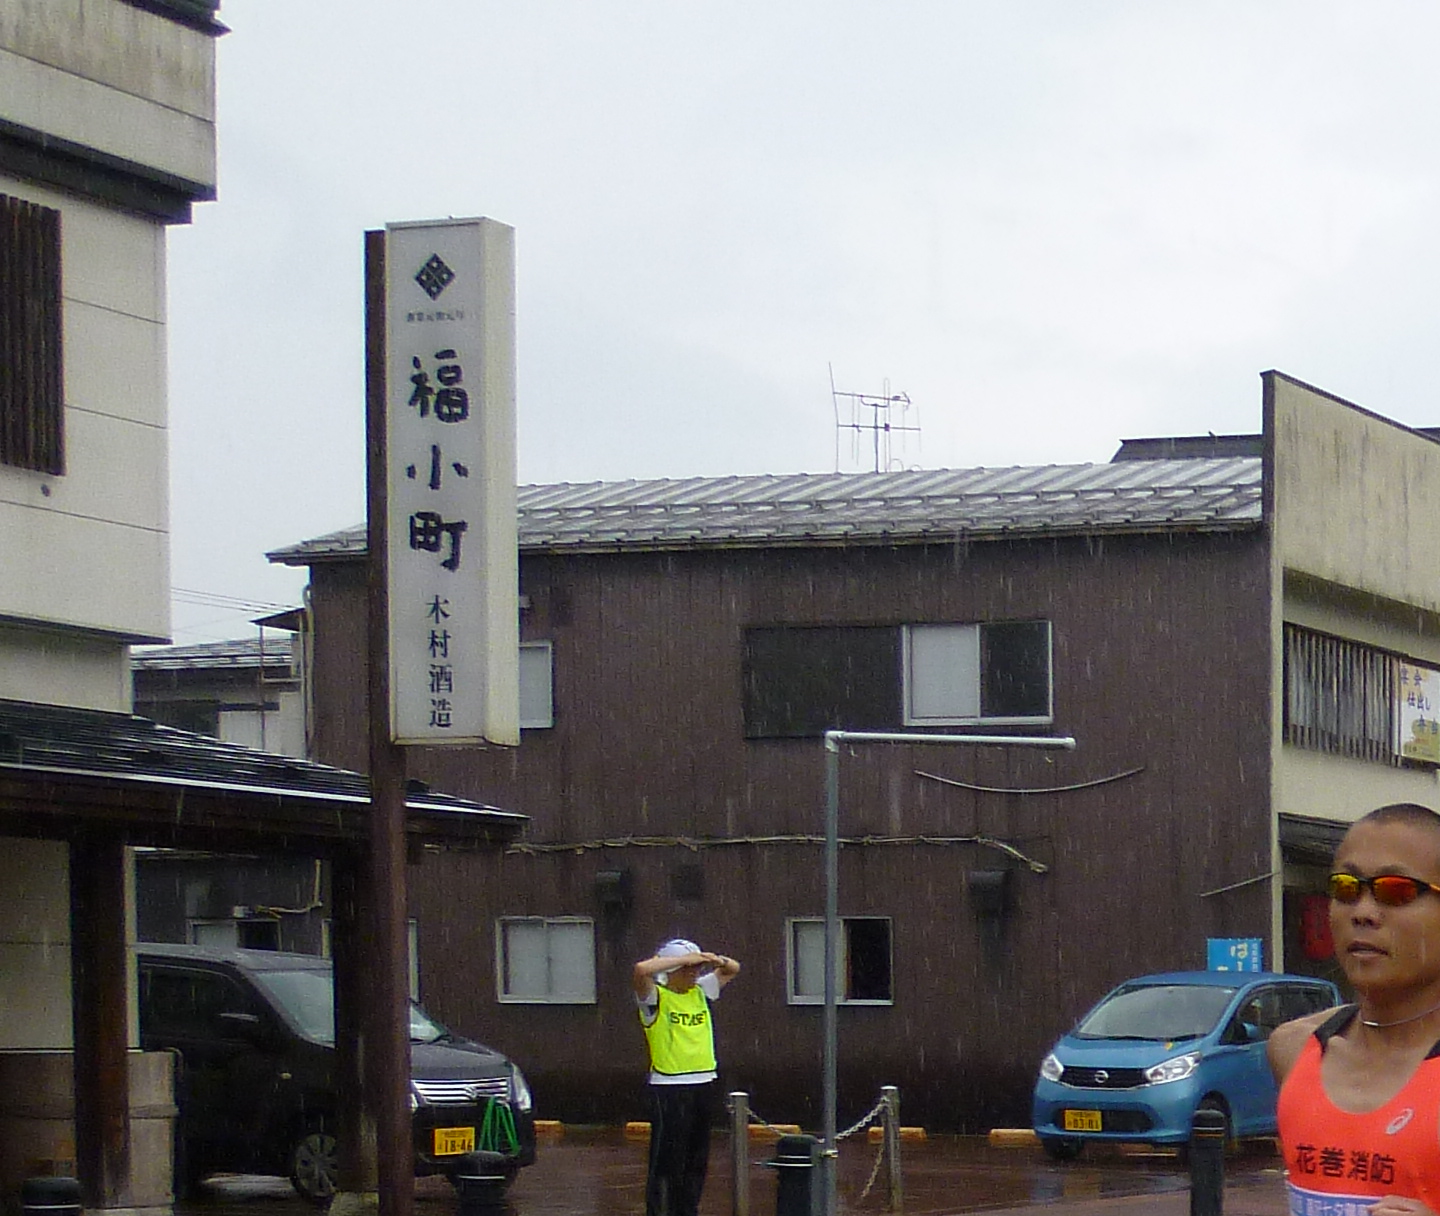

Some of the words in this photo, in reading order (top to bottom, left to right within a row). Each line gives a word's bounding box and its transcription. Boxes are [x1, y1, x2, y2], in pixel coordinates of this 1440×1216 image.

[406, 349, 470, 571] 福小町
[427, 595, 453, 728] 木村酒造
[1296, 1143, 1397, 1185] 花巻消防
